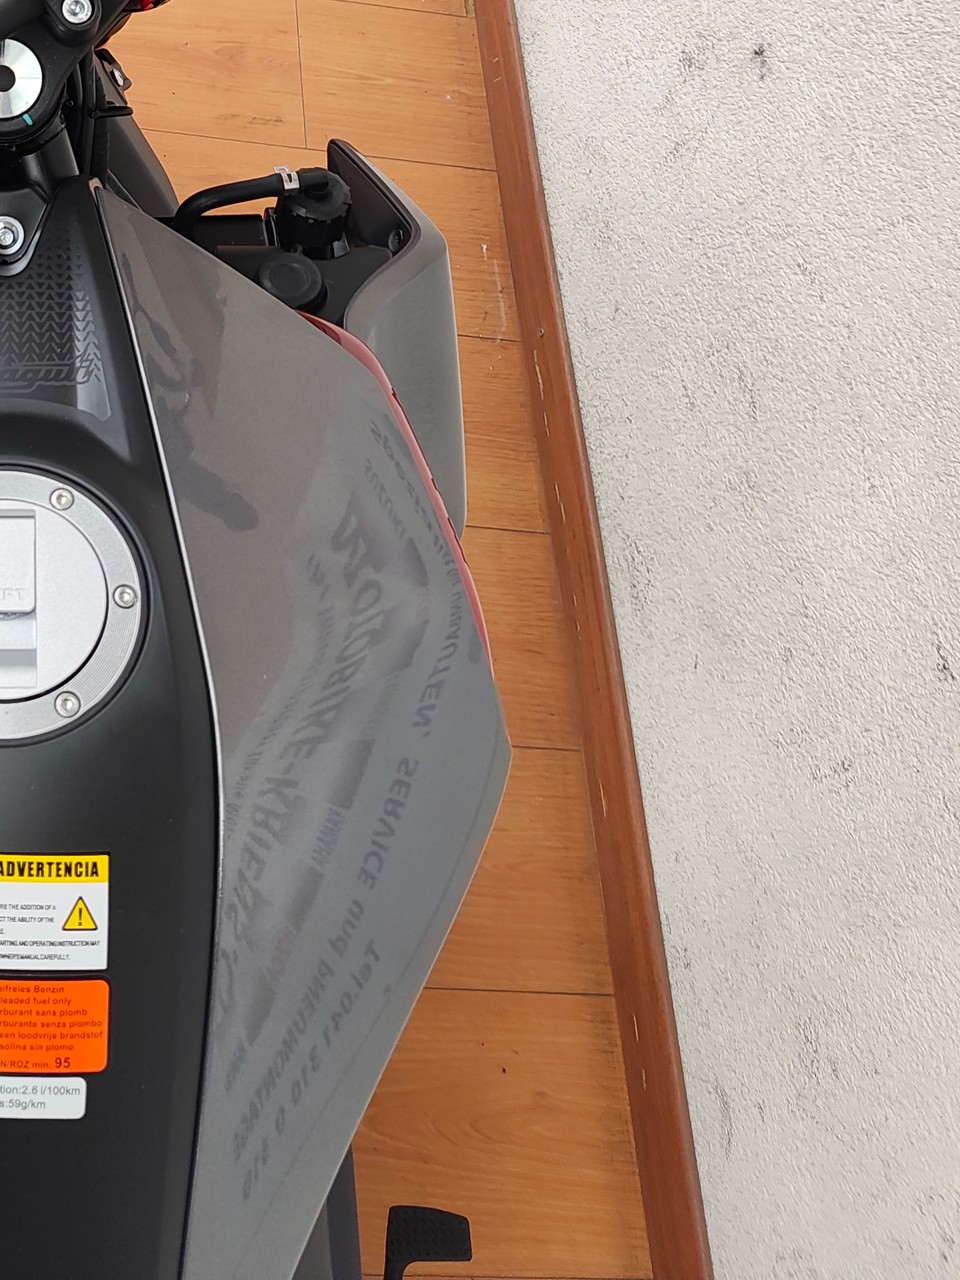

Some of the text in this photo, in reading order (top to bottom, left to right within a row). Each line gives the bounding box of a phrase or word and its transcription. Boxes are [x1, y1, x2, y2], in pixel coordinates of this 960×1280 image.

[33, 985, 65, 994] Benzin
[33, 996, 50, 1005] fuel
[52, 997, 72, 1007] only
[36, 1009, 57, 1017] sans
[60, 1008, 88, 1018] plomb
[60, 1030, 103, 1040] brandstof
[30, 1042, 43, 1051] sin
[54, 1057, 71, 1069] 95
